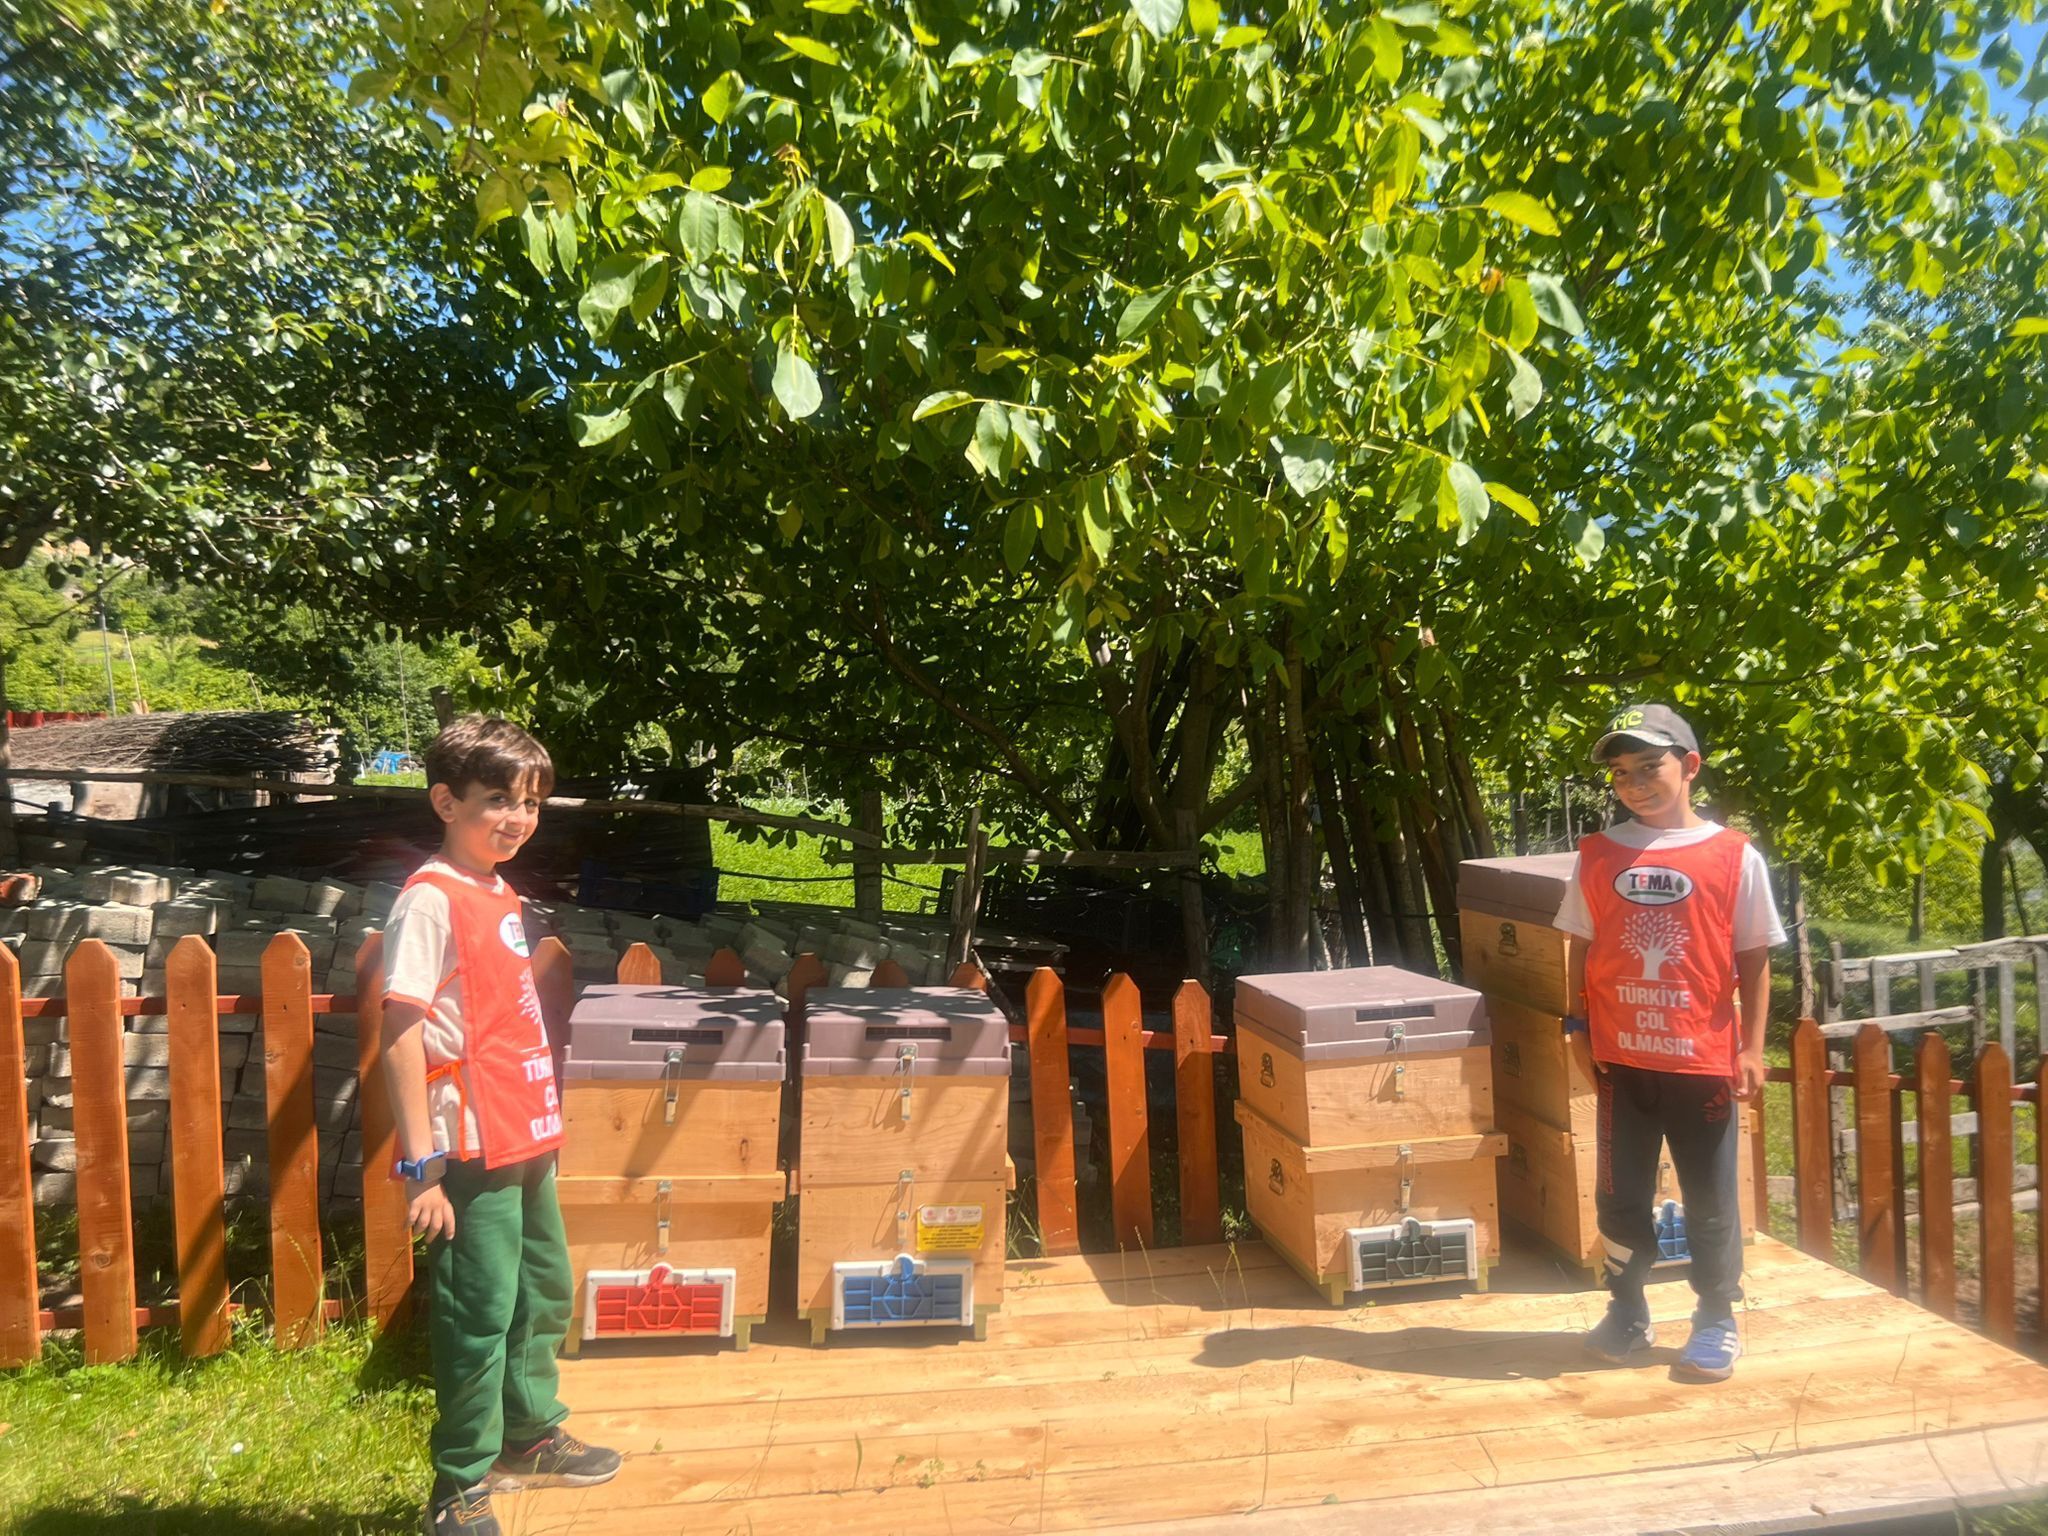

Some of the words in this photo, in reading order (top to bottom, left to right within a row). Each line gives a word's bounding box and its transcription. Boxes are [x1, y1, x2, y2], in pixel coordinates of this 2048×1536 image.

[1629, 873, 1673, 891] TEMA
[1615, 982, 1690, 1009] TÜRKİYE
[1636, 1007, 1670, 1033] ÇÖL
[1617, 1031, 1695, 1056] OLMASIN
